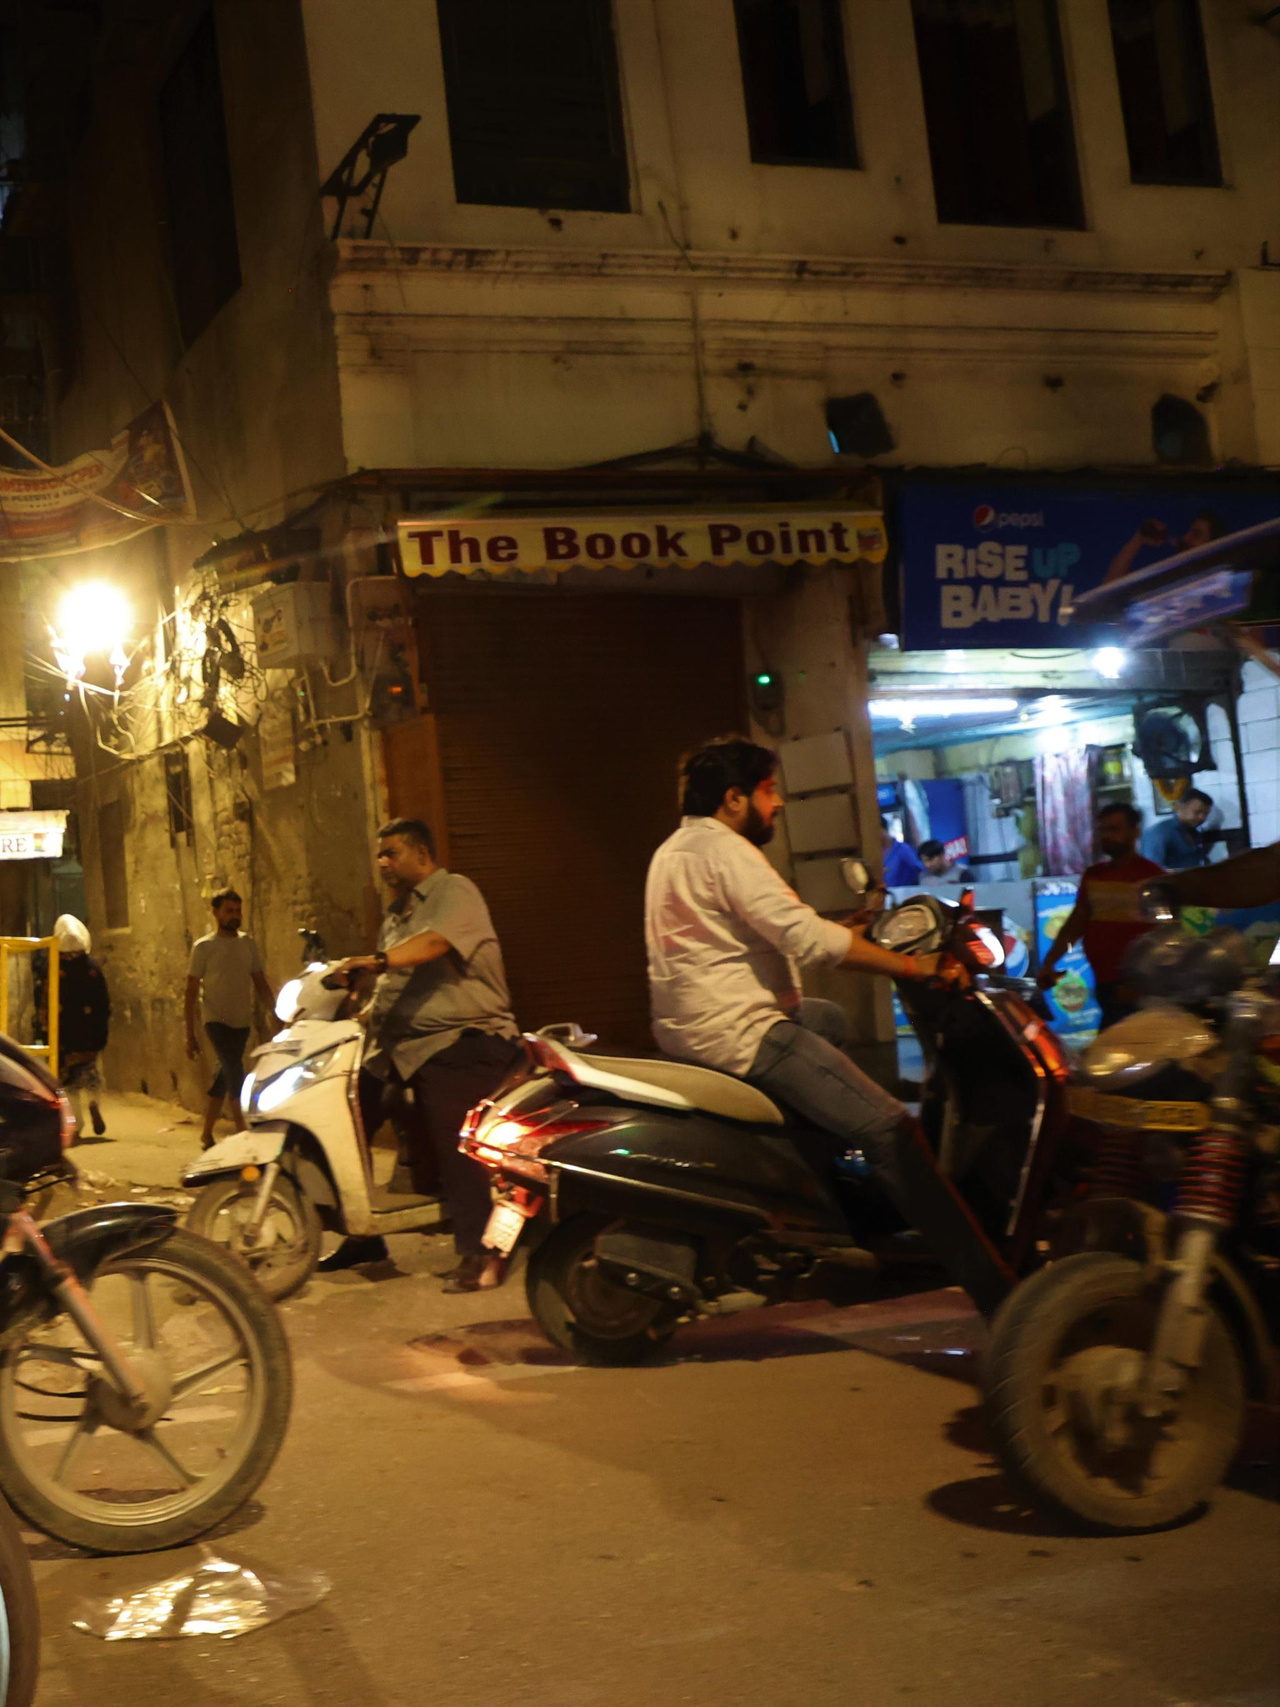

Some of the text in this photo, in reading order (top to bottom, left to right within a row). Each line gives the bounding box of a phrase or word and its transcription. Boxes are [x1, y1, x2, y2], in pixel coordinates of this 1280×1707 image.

[997, 512, 1045, 528] pepsi
[408, 521, 850, 566] The Book Point
[935, 541, 1081, 581] RISE UP
[940, 579, 1075, 629] BABY!
